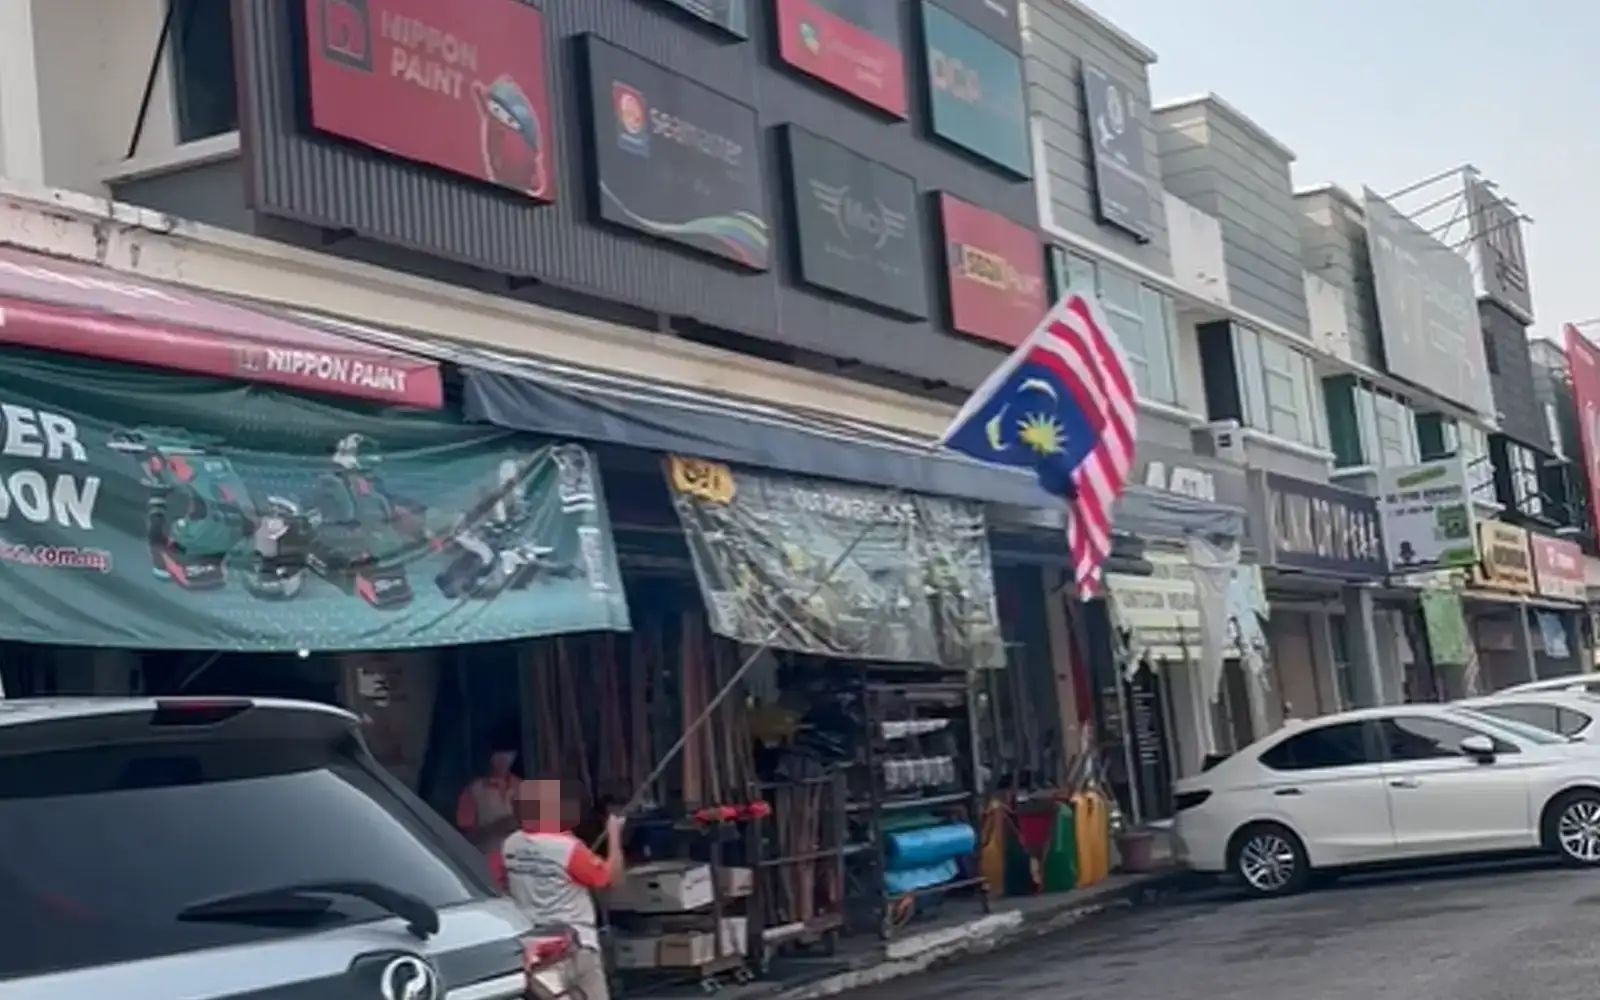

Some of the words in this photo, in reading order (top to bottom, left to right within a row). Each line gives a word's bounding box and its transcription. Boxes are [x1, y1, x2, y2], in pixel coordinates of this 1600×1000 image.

[381, 9, 478, 71] NIPPON
[391, 47, 463, 99] PAINT
[266, 348, 350, 383] NIPPON
[351, 361, 406, 392] PAINT
